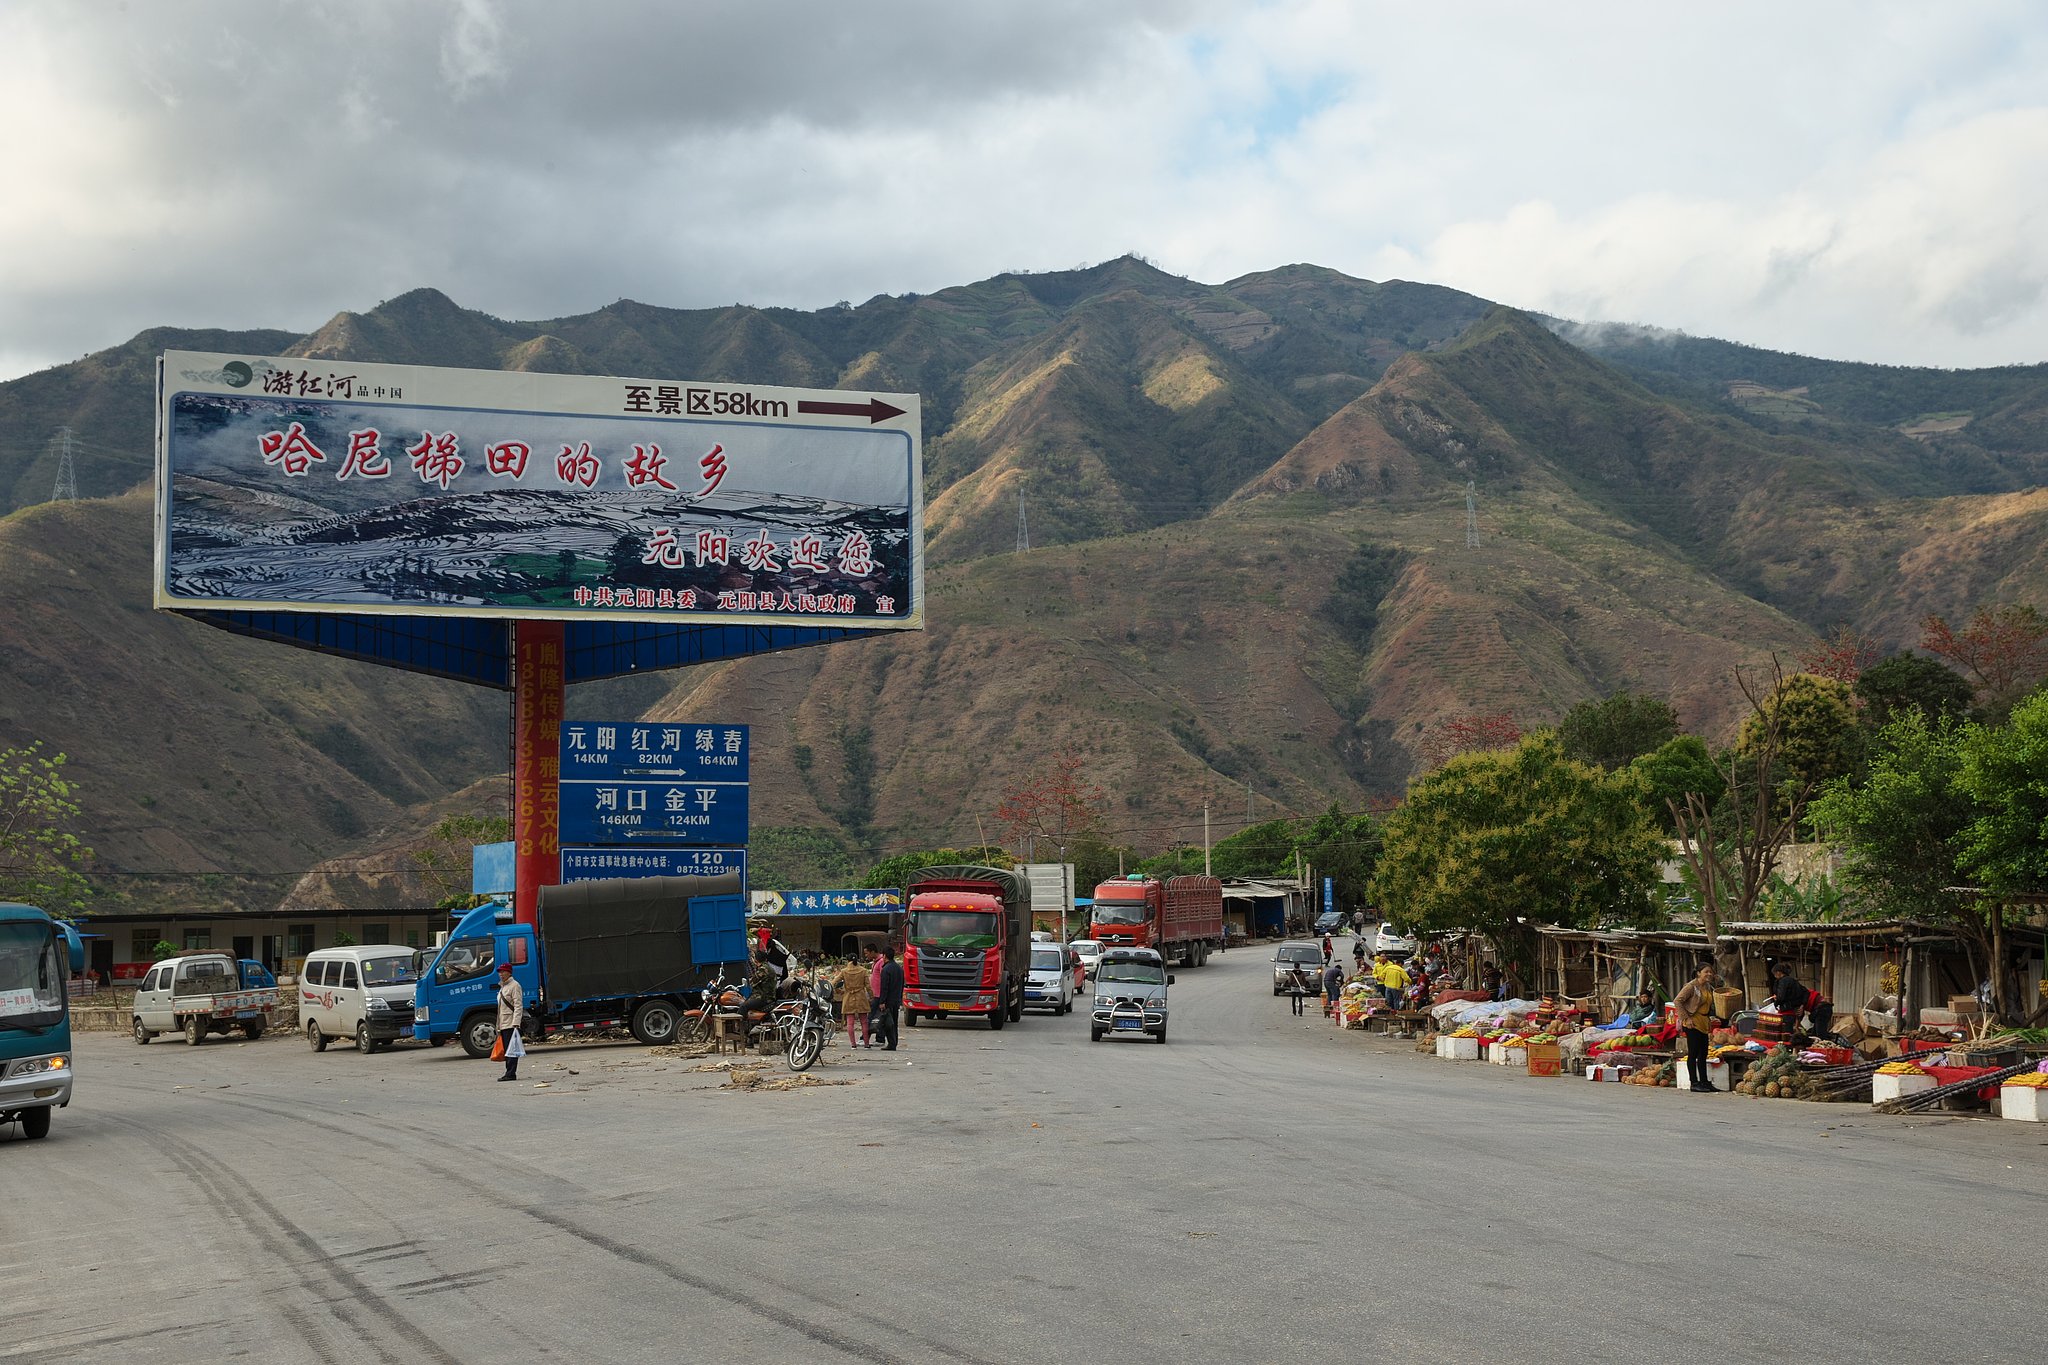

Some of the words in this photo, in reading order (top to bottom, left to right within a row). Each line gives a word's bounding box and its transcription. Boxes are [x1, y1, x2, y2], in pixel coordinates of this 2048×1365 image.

[263, 370, 357, 398] 游红河
[357, 386, 402, 398] 品中国
[624, 385, 789, 418] 至景区58km
[259, 422, 729, 497] 哈尼梯田的故乡
[643, 527, 877, 576] 元阳欢迎您
[574, 586, 696, 609] 中共元阳县委
[717, 591, 855, 614] 元阳县人民政府
[876, 595, 895, 613] 宣
[567, 727, 616, 750] 元阳
[631, 728, 681, 751] 红河
[695, 729, 742, 752] 绿春
[573, 754, 608, 764] 14KM
[638, 754, 672, 764] 82KM
[699, 755, 738, 766] 164KM
[595, 788, 647, 811] 河口
[664, 788, 717, 811] 金平
[600, 815, 642, 825] 146KM
[670, 815, 710, 825] 124KM
[692, 853, 723, 864] 120
[939, 951, 965, 959] JAC
